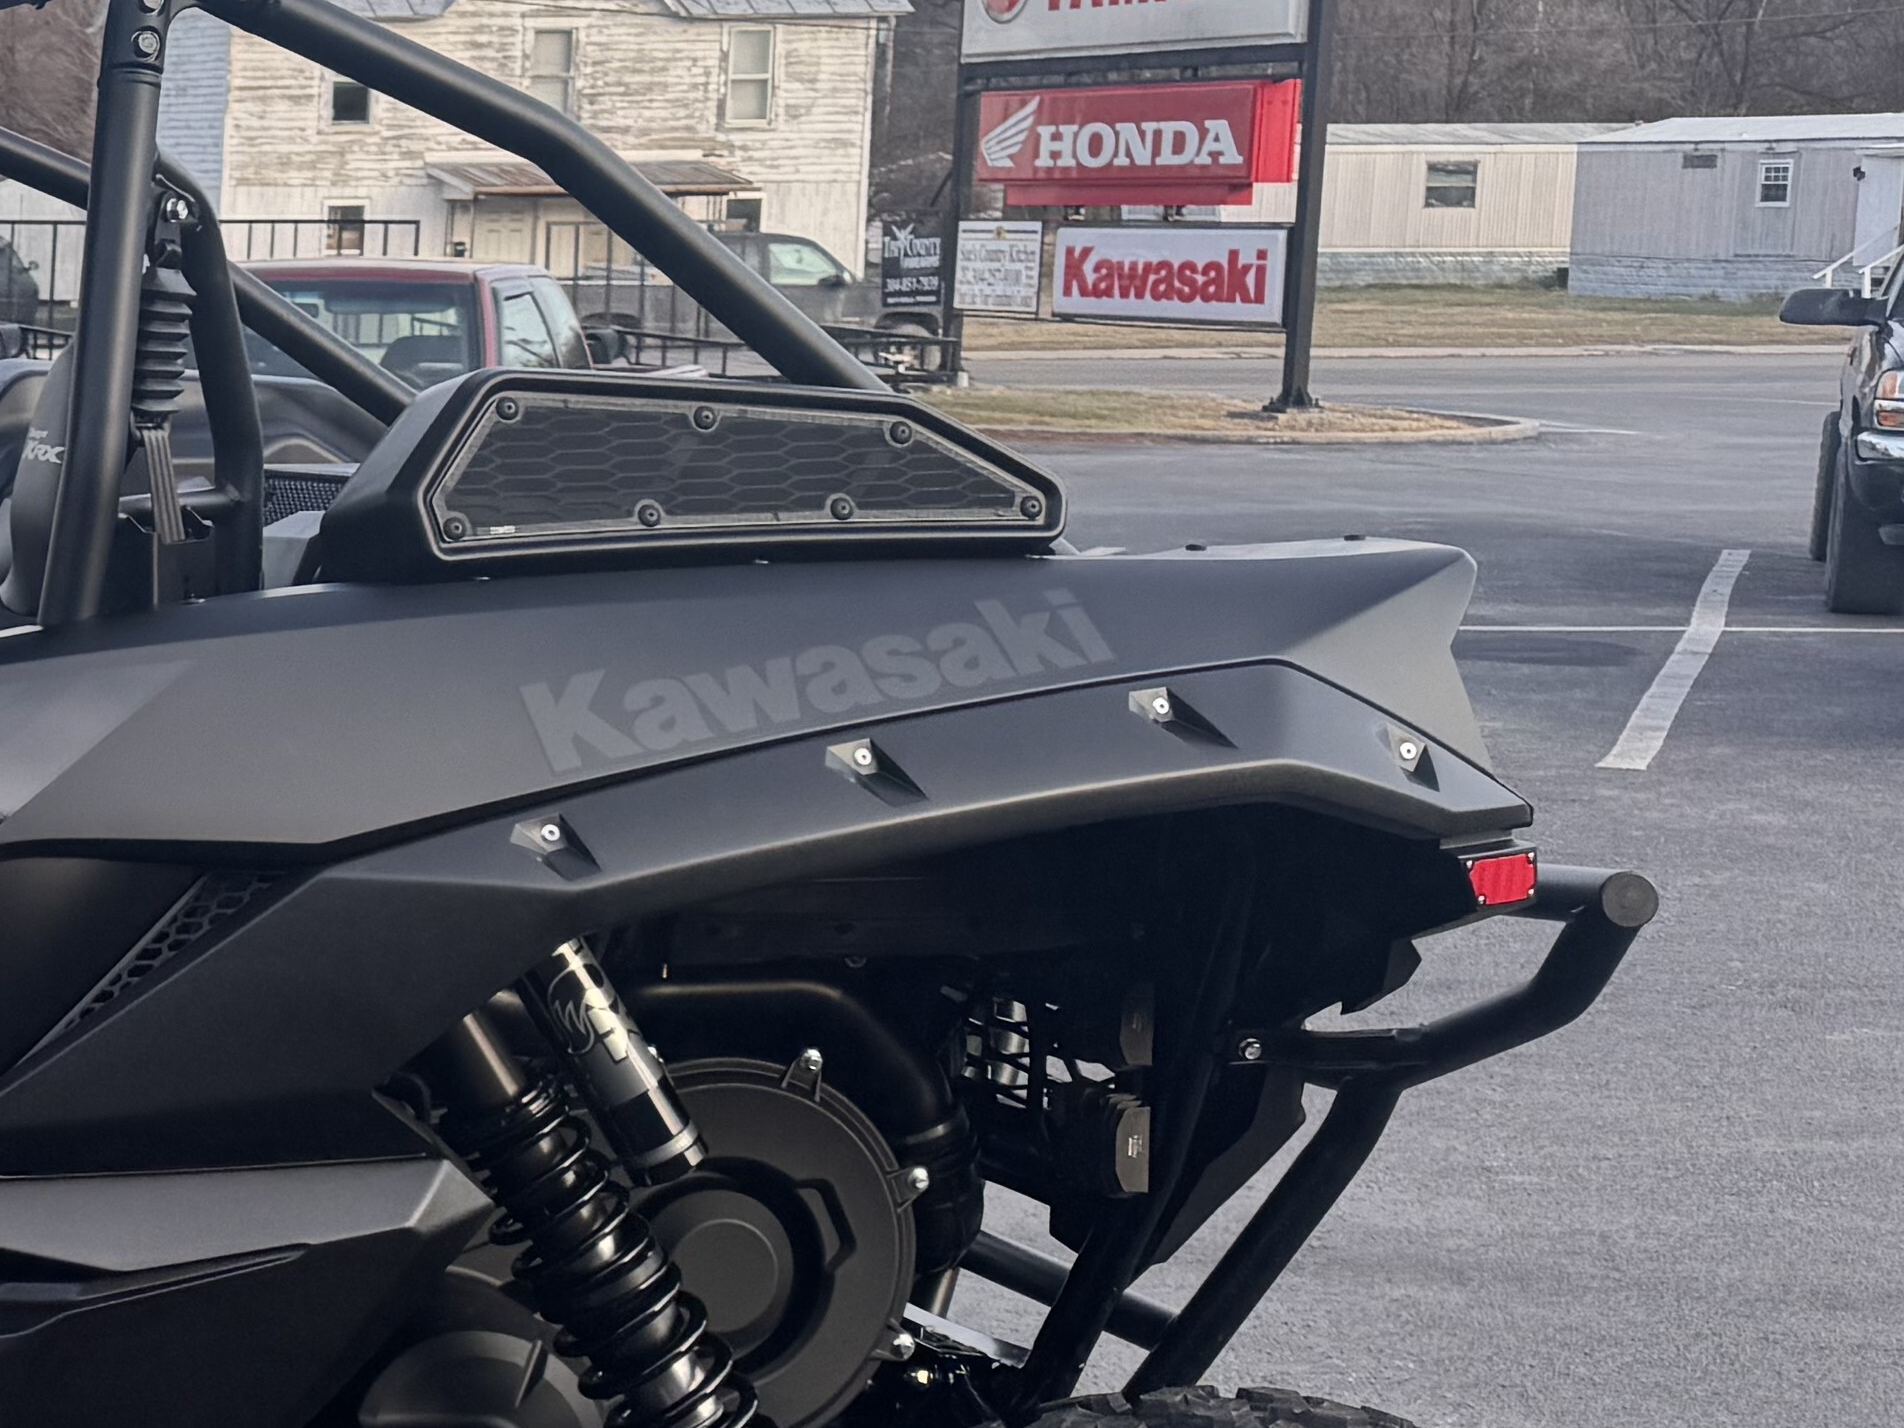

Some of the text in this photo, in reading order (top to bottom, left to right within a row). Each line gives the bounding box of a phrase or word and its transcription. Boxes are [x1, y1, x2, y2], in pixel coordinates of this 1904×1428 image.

[1034, 118, 1243, 169] HONDA
[1062, 245, 1268, 306] Kawasaki
[516, 587, 1120, 774] Kawasaki
